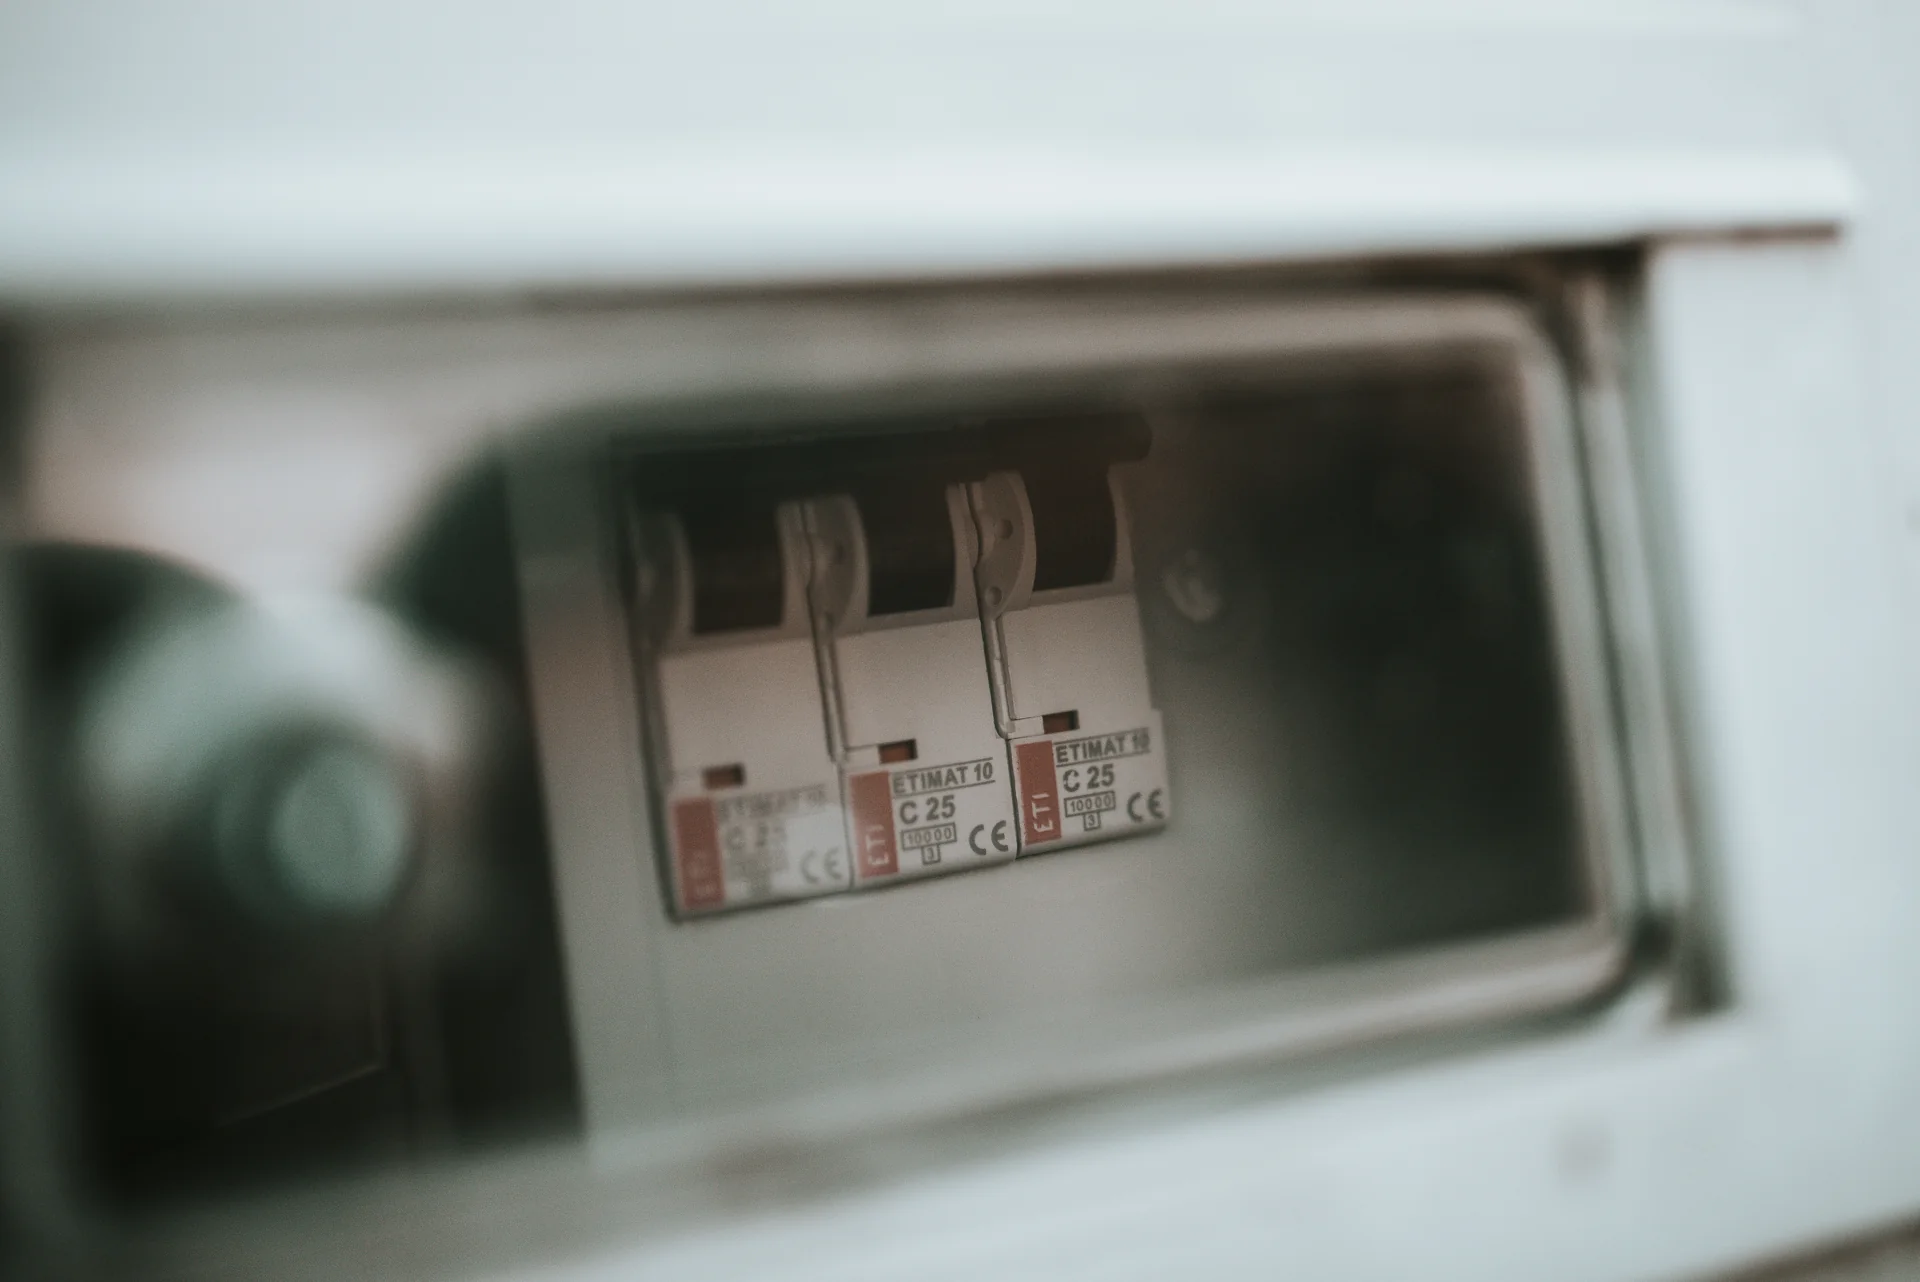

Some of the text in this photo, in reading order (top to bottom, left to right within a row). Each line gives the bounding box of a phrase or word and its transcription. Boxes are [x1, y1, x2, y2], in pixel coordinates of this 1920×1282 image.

[1055, 735, 1128, 763] ETIMAT
[893, 761, 994, 794] ETIMAT 10
[1063, 763, 1115, 792] C 25
[899, 794, 956, 825] C 25
[1031, 793, 1054, 833] ETI
[1070, 794, 1111, 813] 10000
[866, 824, 890, 867] ETI
